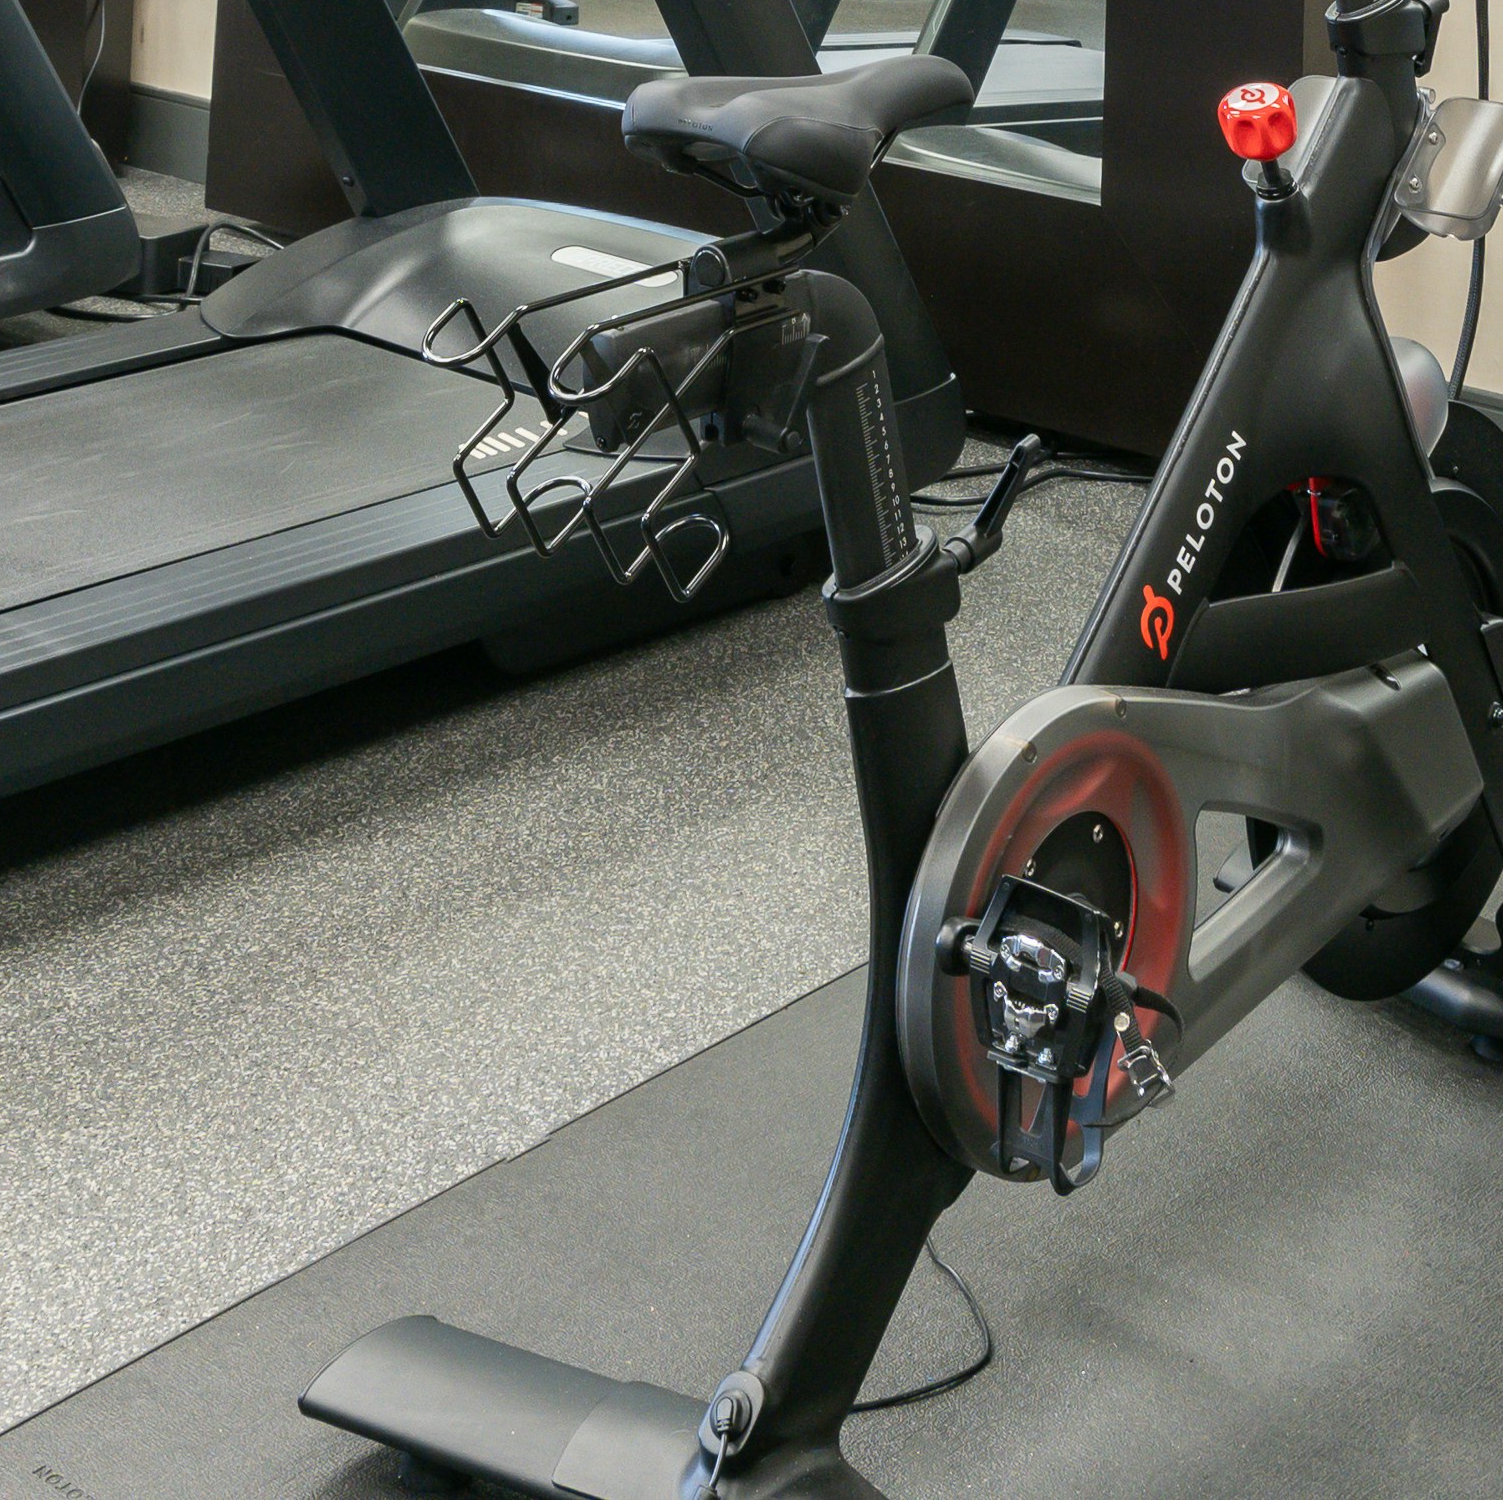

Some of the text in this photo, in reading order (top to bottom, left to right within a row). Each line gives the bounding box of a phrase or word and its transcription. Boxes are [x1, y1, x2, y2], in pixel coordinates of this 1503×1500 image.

[872, 370, 876, 379] 1
[874, 384, 879, 394] 2
[877, 398, 882, 408] 3
[879, 412, 884, 421] 4
[881, 427, 886, 436] 5
[884, 441, 889, 450] 6
[886, 454, 891, 464] 7
[888, 469, 894, 478] 8
[891, 482, 896, 492] 9
[892, 495, 900, 506] 10
[894, 510, 902, 520] 11
[1166, 430, 1247, 595] PELOTON
[897, 523, 905, 534] 12
[899, 537, 907, 548] 13
